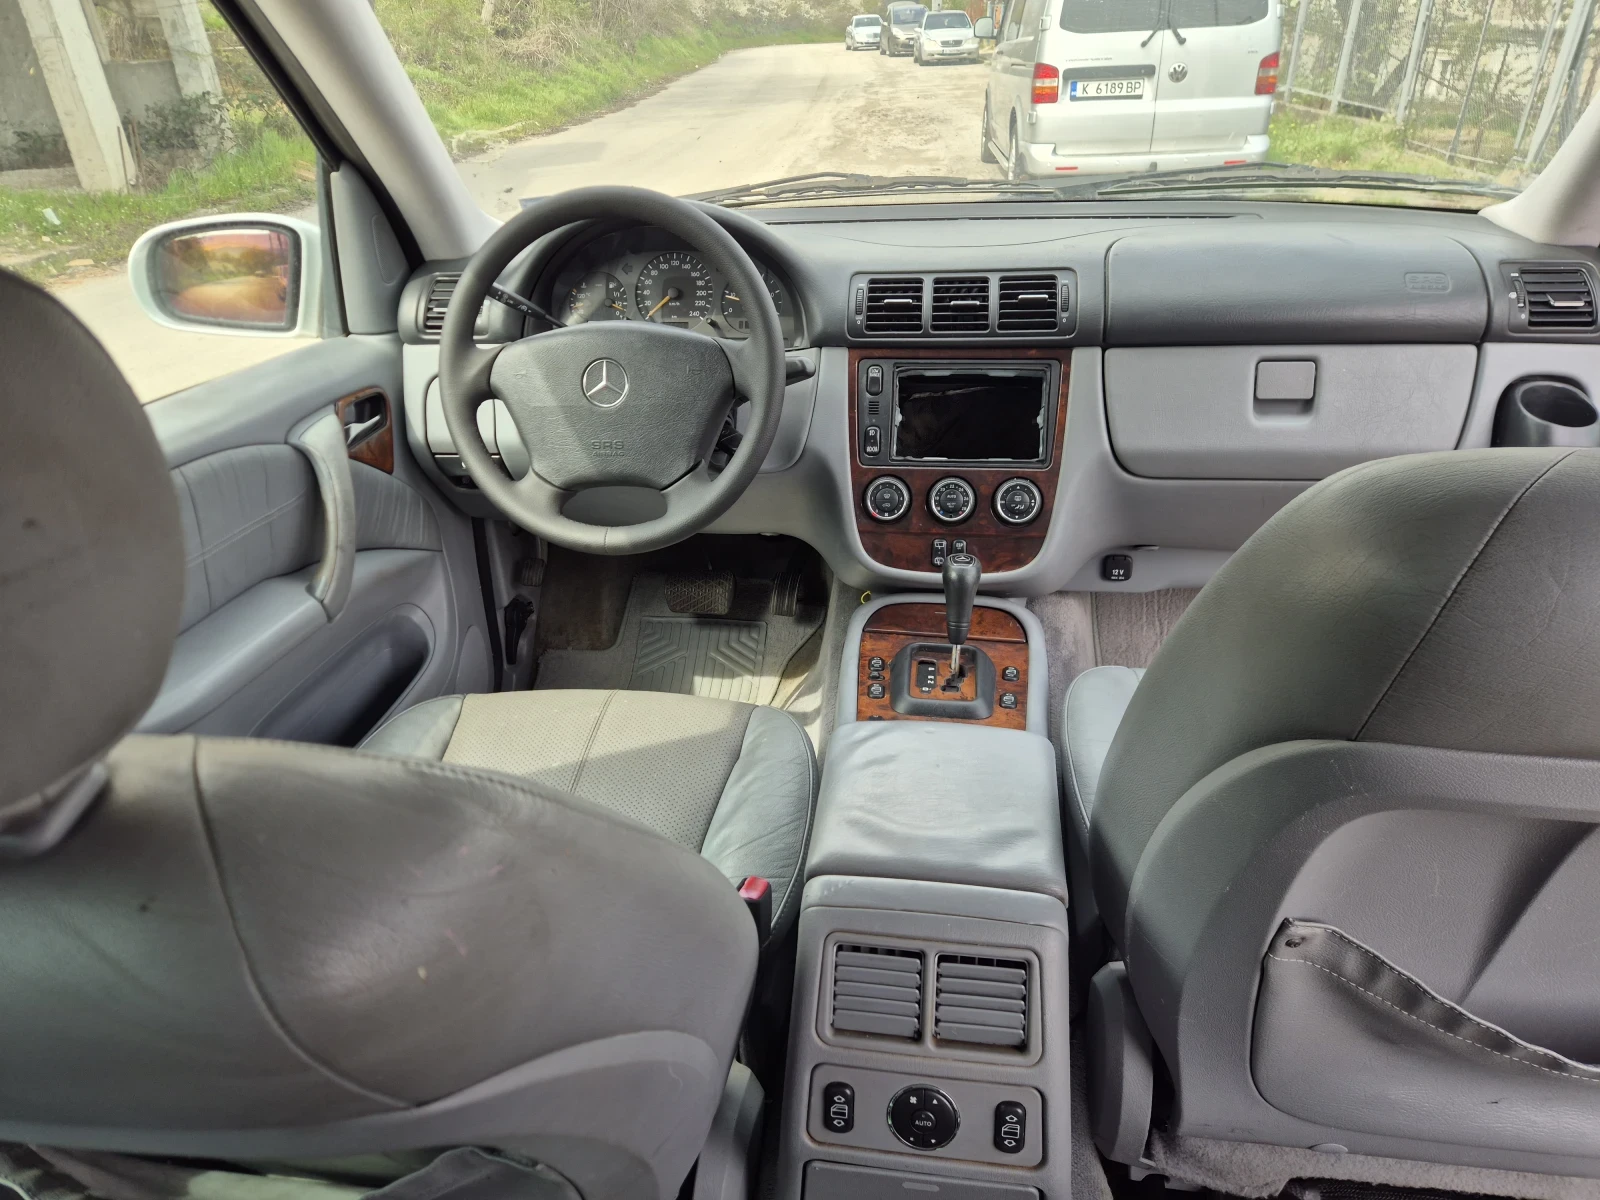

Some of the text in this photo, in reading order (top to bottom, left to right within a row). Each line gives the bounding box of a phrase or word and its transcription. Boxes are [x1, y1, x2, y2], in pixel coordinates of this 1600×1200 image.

[1082, 84, 1090, 95] K
[1096, 82, 1124, 94] 6189
[1126, 82, 1142, 94] BP
[591, 440, 624, 450] SRS
